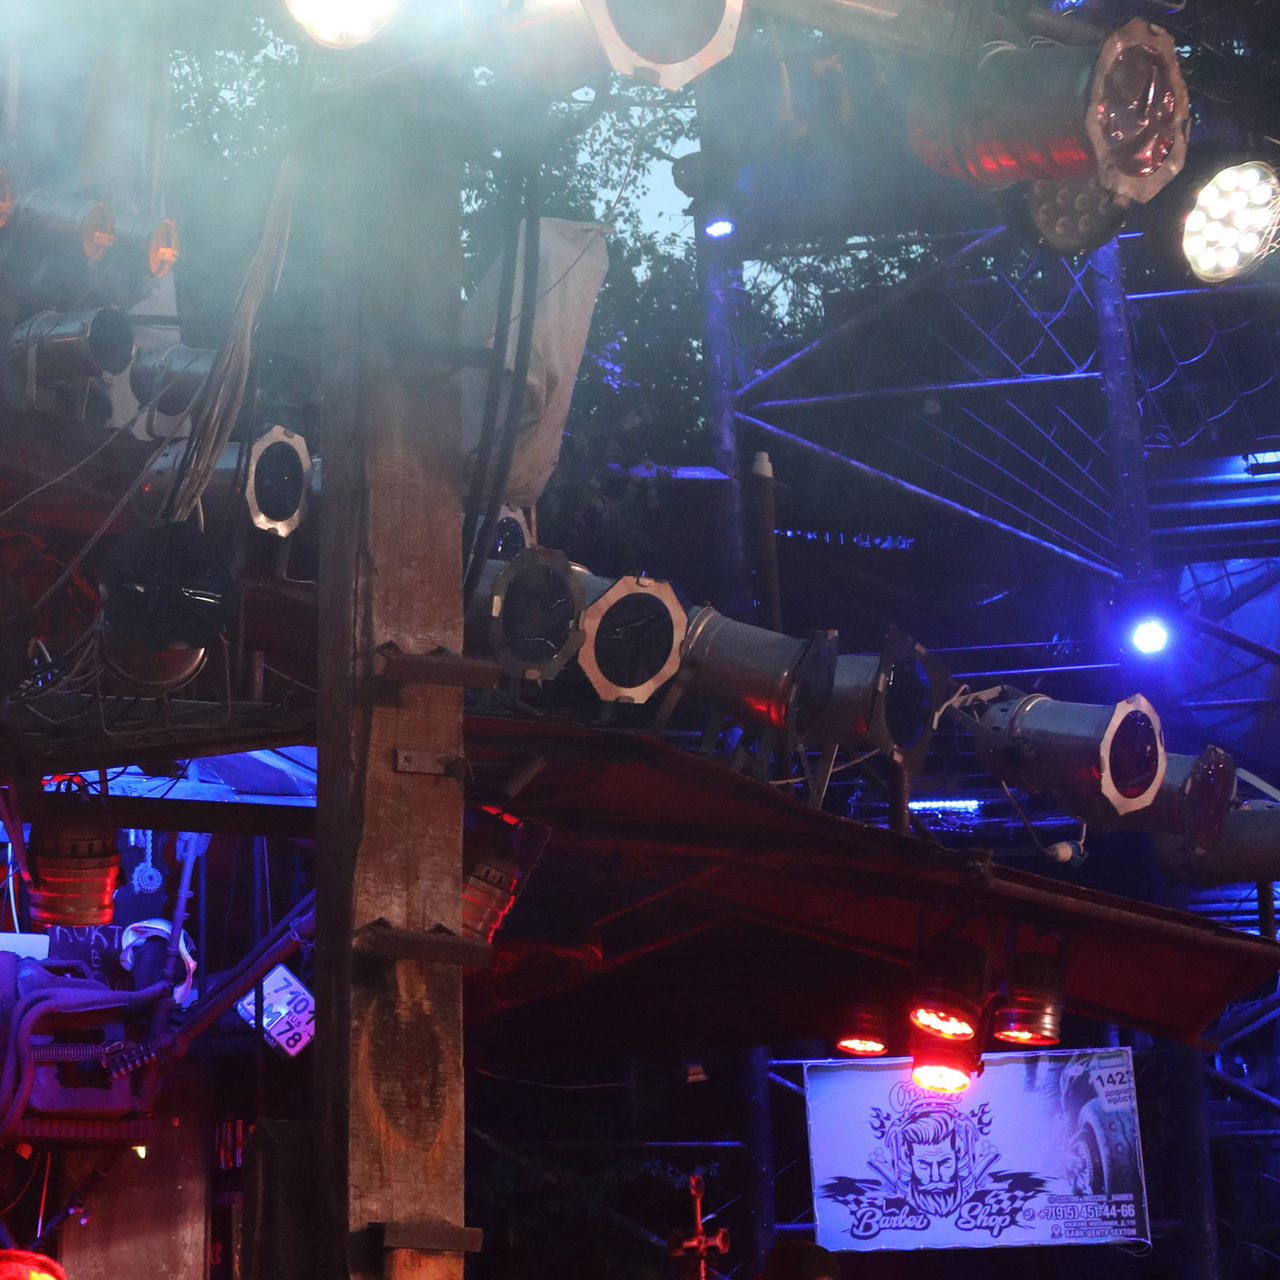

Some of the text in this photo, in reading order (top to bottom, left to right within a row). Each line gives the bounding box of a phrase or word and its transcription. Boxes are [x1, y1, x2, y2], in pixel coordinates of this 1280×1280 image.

[285, 1010, 301, 1027] RUS
[276, 1020, 302, 1048] 78
[852, 1202, 1012, 1239] Barber Shop
